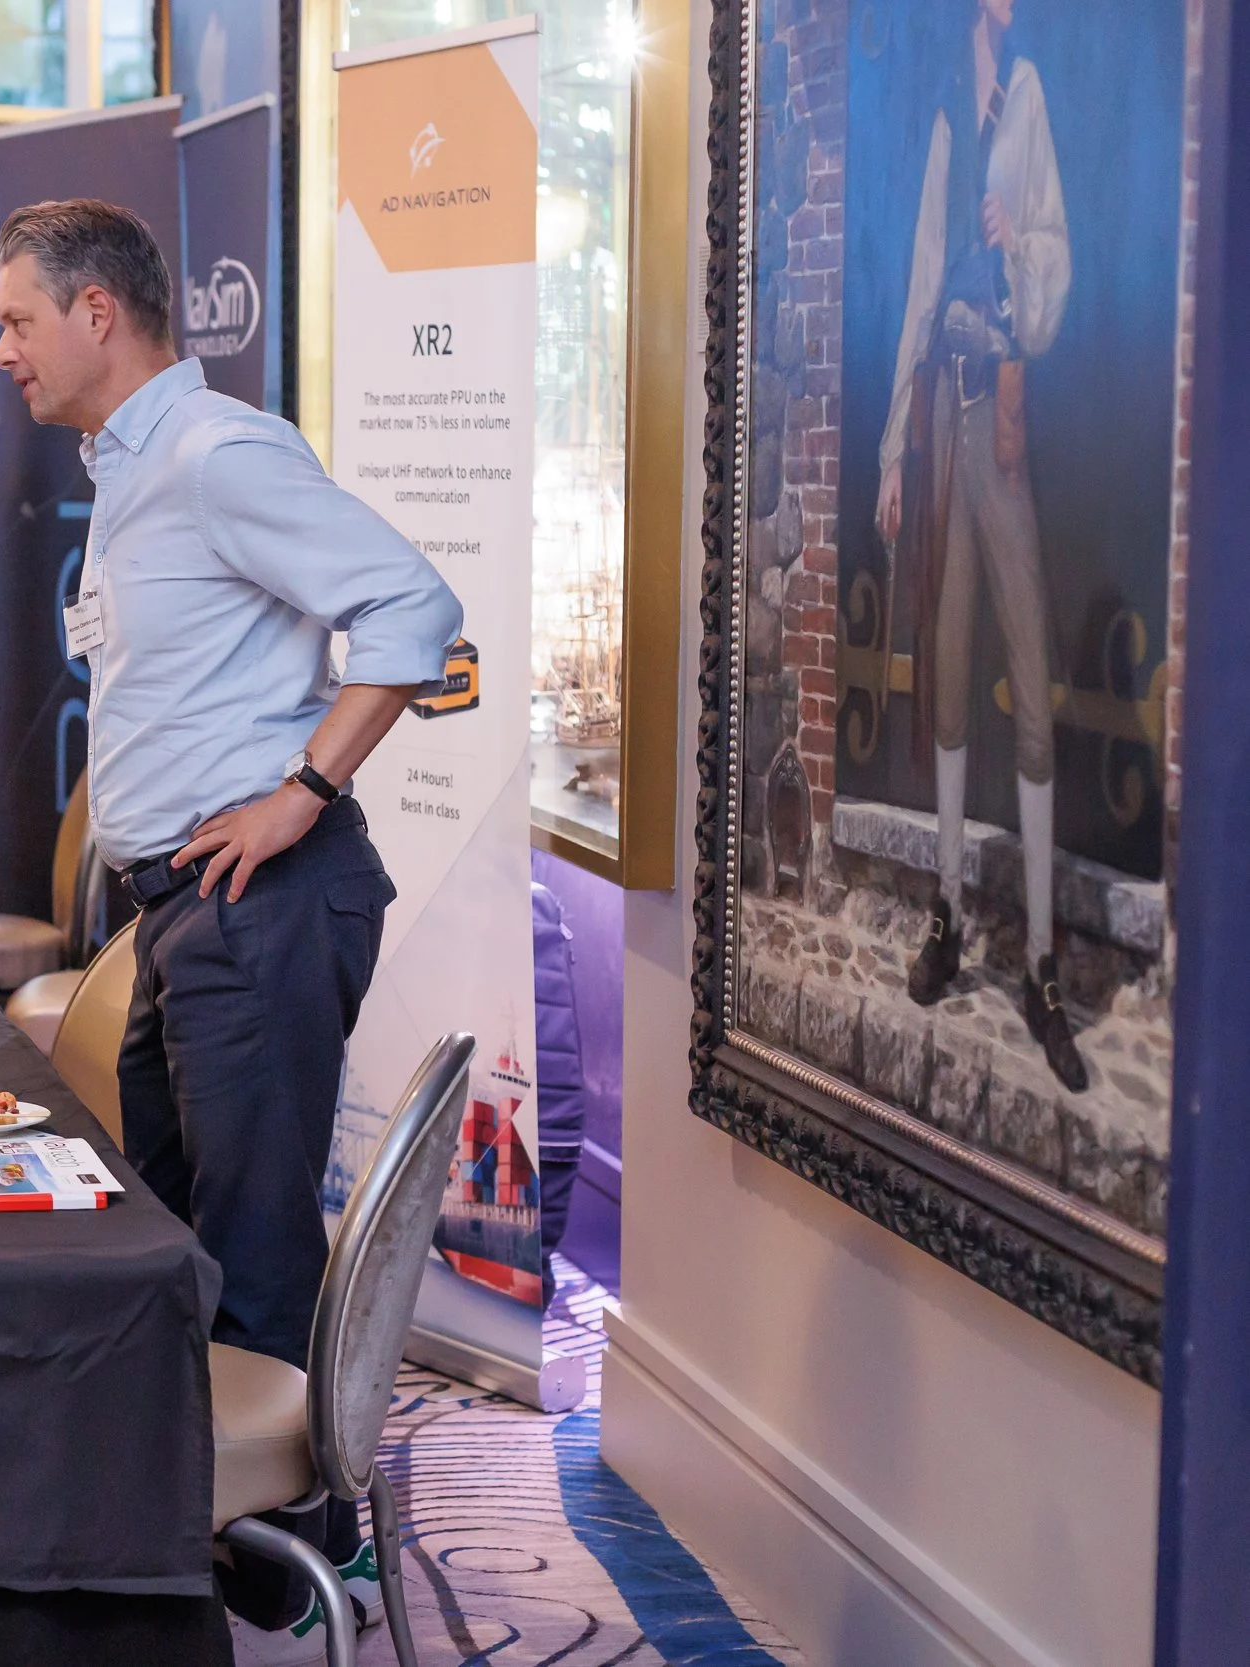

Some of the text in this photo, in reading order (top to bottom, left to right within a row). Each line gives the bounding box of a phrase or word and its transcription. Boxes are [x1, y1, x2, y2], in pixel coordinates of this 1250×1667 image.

[380, 186, 491, 213] AD NAVIGATION
[412, 324, 453, 356] XR2
[364, 388, 506, 406] The most accurate PPU on the
[359, 414, 511, 430] market now 75 % less in volume
[357, 462, 512, 482] Unique UHF network to enhance
[394, 488, 470, 504] communication
[423, 540, 445, 555] your
[447, 539, 481, 555] pocket
[407, 767, 454, 789] 24 Hours!
[401, 796, 461, 821] Best in class
